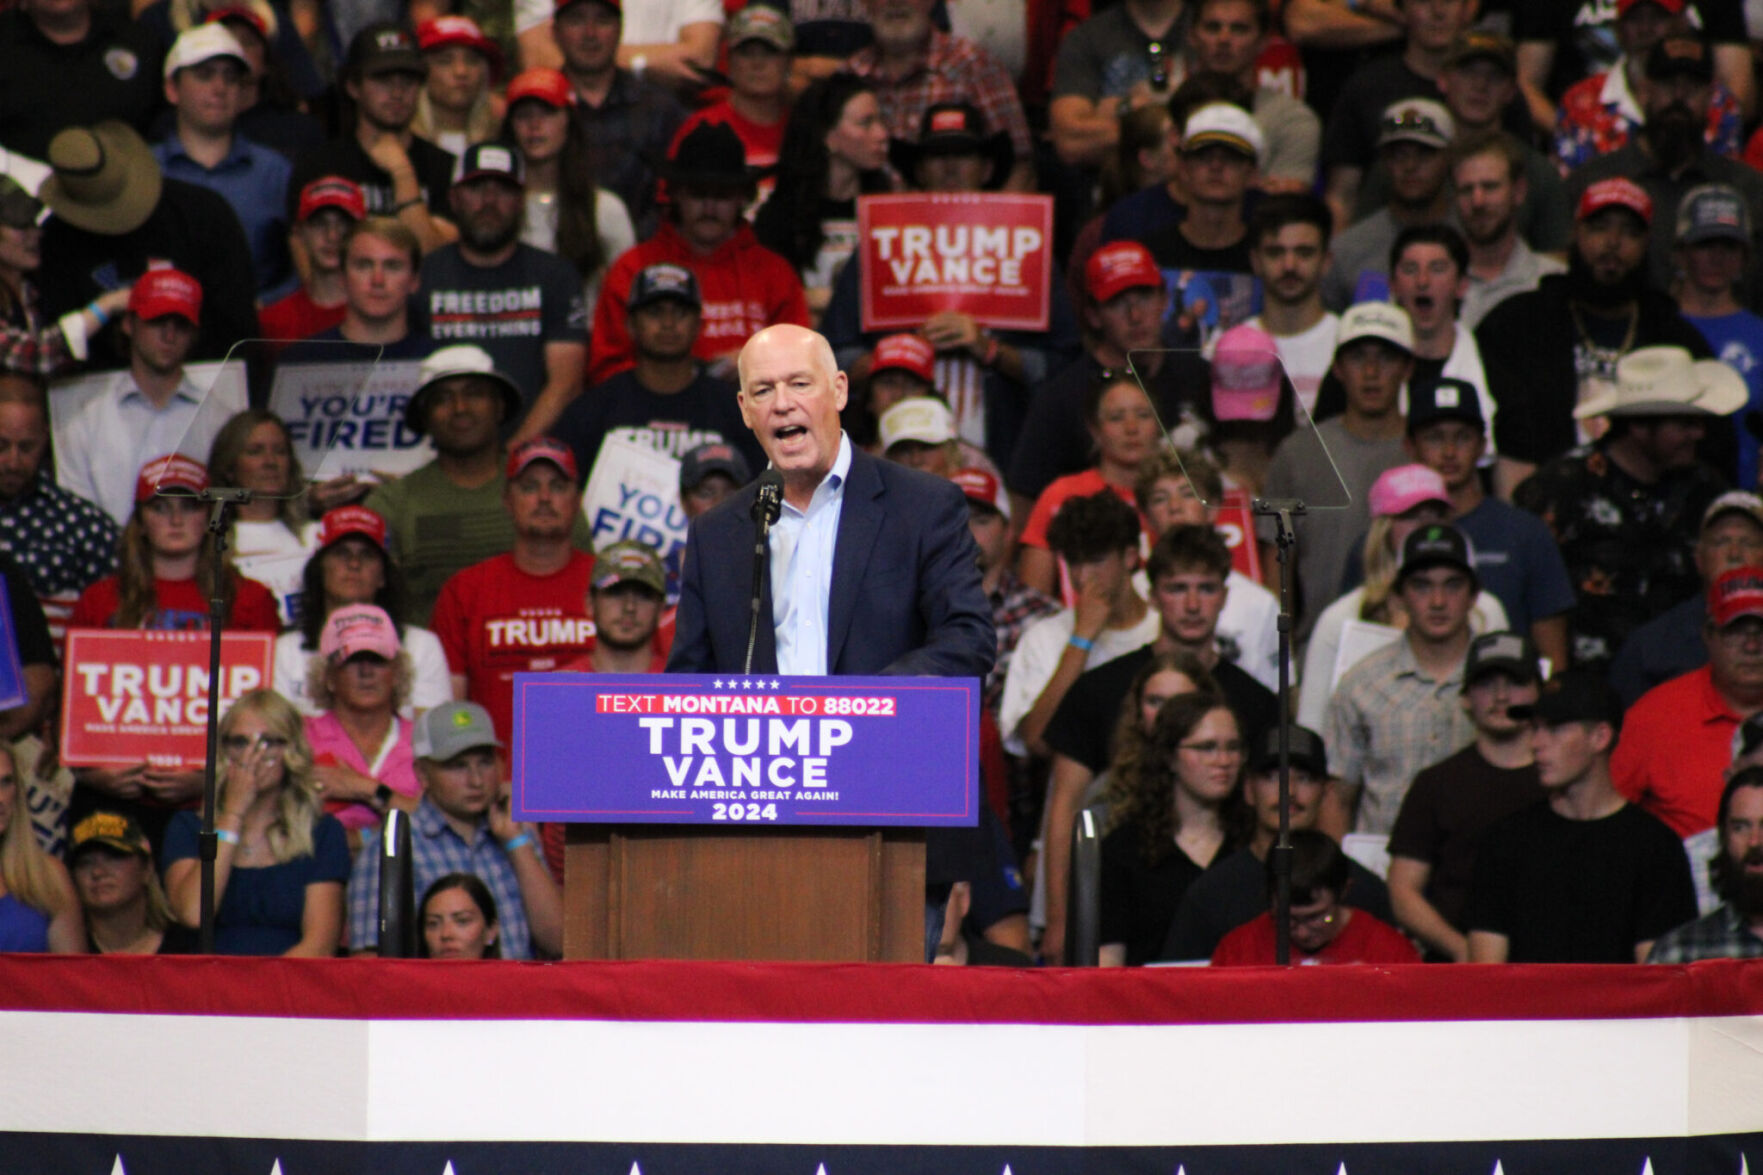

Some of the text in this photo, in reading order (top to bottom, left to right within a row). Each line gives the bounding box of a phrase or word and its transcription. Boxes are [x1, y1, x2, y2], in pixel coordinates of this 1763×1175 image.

[871, 225, 1042, 260] TRUMP
[890, 258, 1021, 285] VANCE
[431, 287, 541, 313] FREEDOM
[432, 320, 541, 339] EVERYTHING
[301, 395, 409, 417] YOU'R
[592, 507, 688, 550] FIR
[485, 618, 597, 646] TRUMP
[77, 663, 260, 698] TRUMP
[599, 695, 894, 715] TEXT MONTANA TO 88022
[639, 717, 853, 755] TRUMP
[662, 756, 828, 787] VANCE
[651, 790, 839, 801] MAKE AMERICA GREAT AGAIN!
[712, 803, 777, 821] 2024
